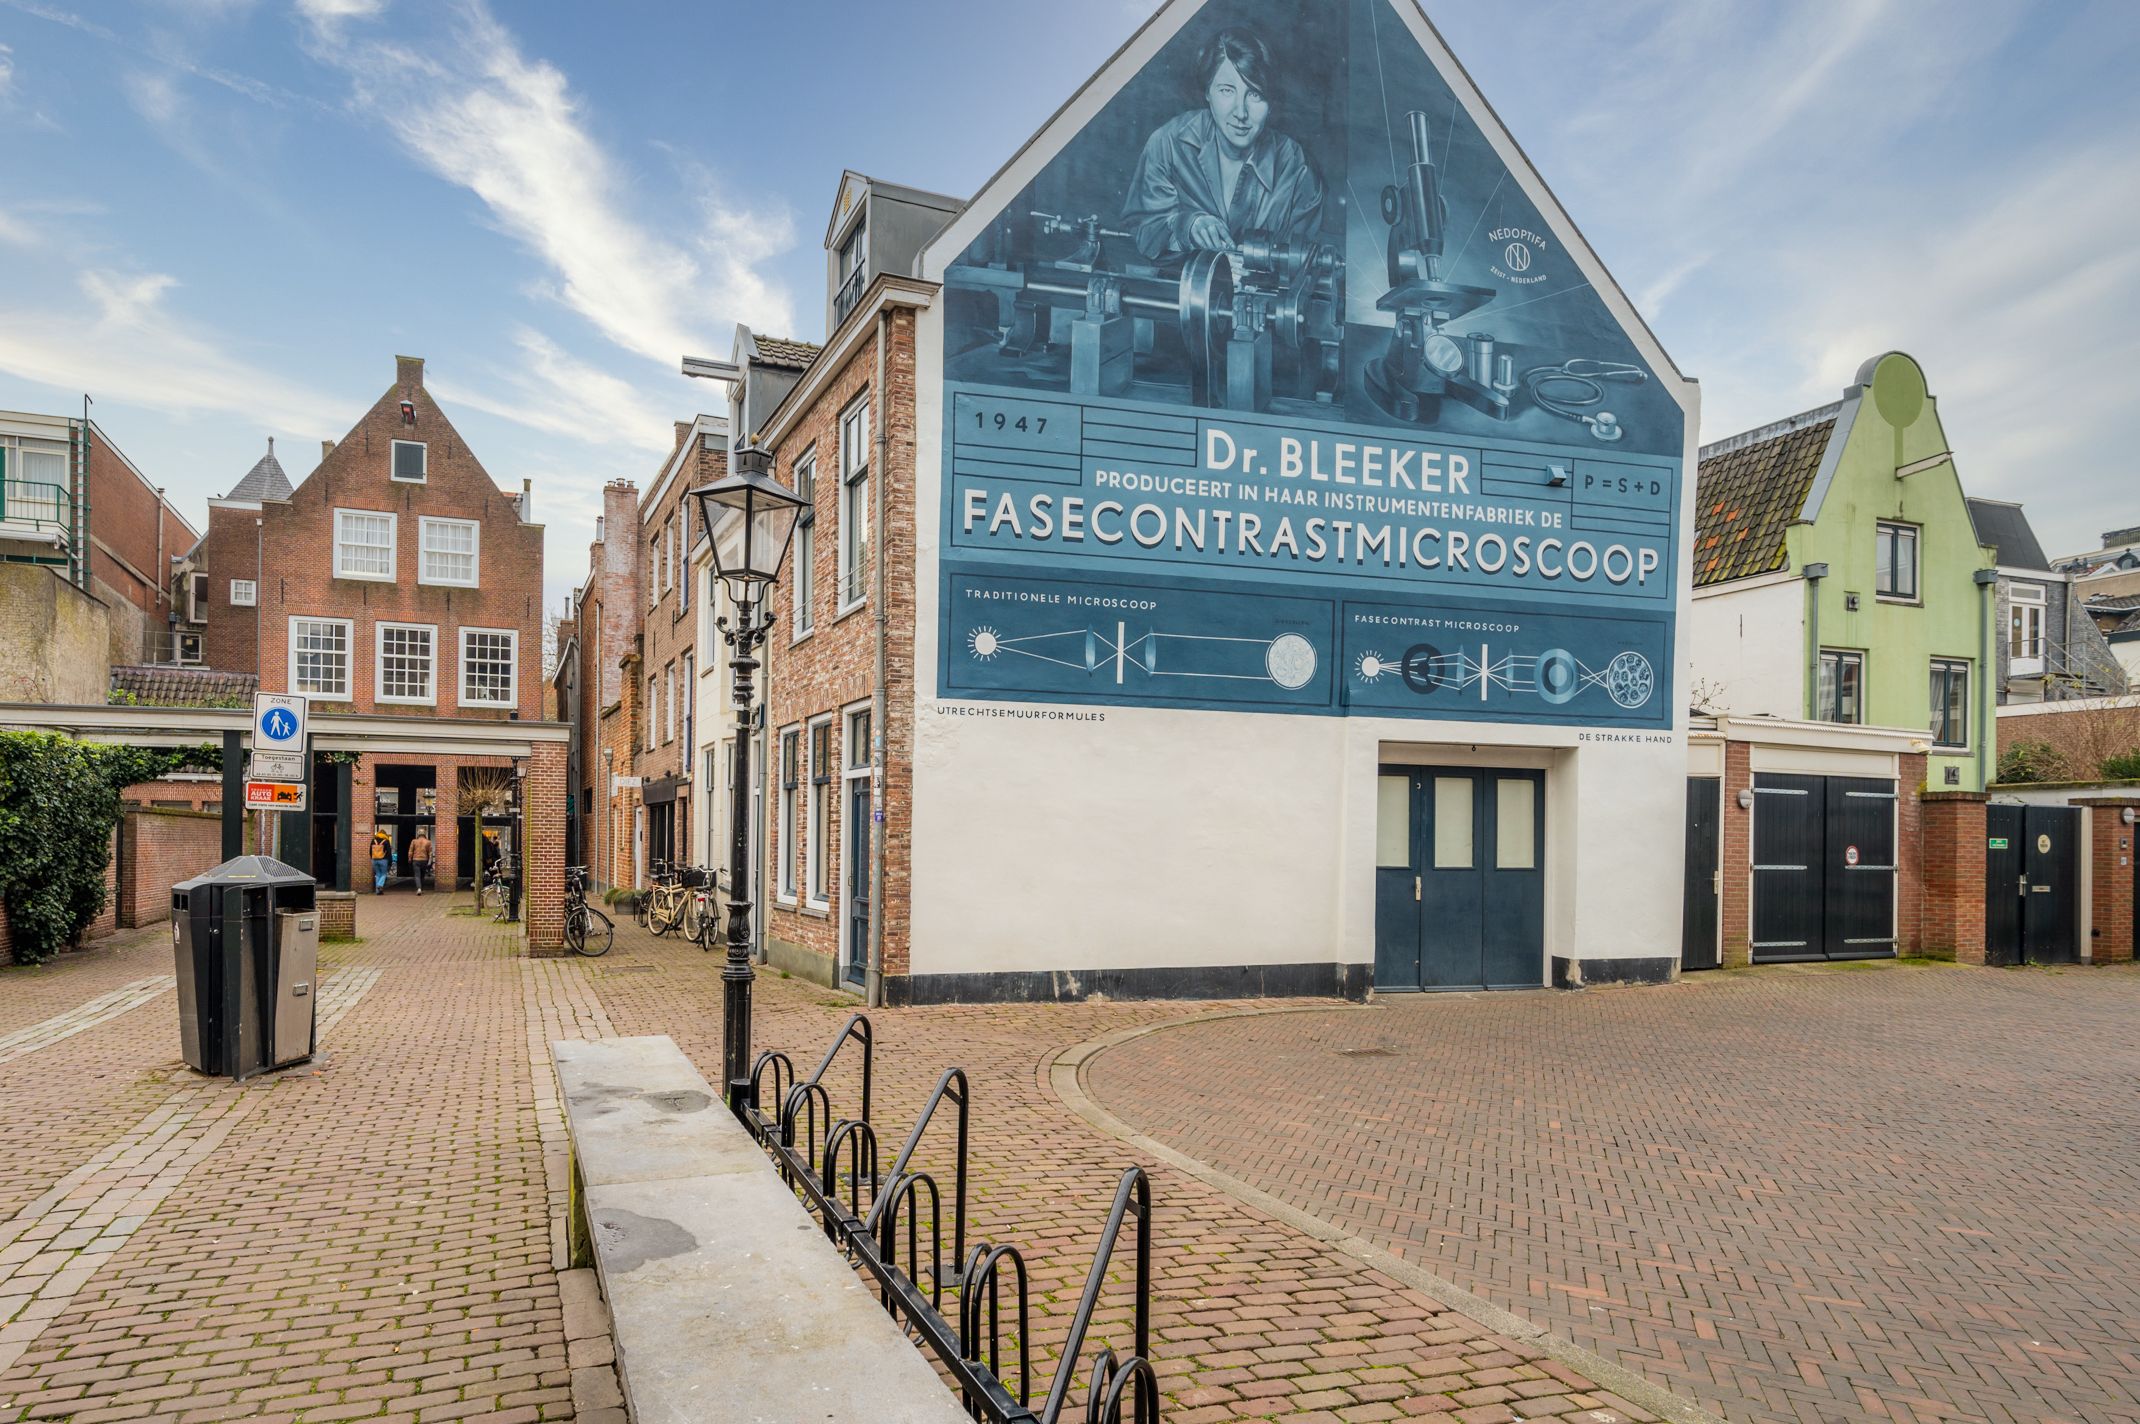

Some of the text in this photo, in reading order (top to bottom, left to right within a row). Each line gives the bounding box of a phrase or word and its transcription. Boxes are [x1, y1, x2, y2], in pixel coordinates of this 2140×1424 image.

[1489, 228, 1546, 251] NEDOPTIFA
[1490, 265, 1506, 279] ZEIST
[1510, 274, 1547, 284] NEDERLAND
[975, 411, 1048, 434] 1947
[1207, 428, 1470, 495] Dr. BLEEKER
[1095, 471, 1562, 529] PRODUCEERT IN HAAR INSTRUMENTENFABRIEK DE
[963, 489, 1658, 586] FASECONTRASTMICROSCOOP
[966, 589, 1157, 610] TRADITIONELE MICROSCOOP
[1354, 615, 1520, 633] FASECONTRAST MICROSCOOP
[270, 697, 292, 705] ZONE
[937, 706, 1106, 722] UTRECHTSEMUURFORMULES
[1579, 733, 1672, 744] DE STRAKKE HAND
[262, 754, 296, 762] Toegestaan
